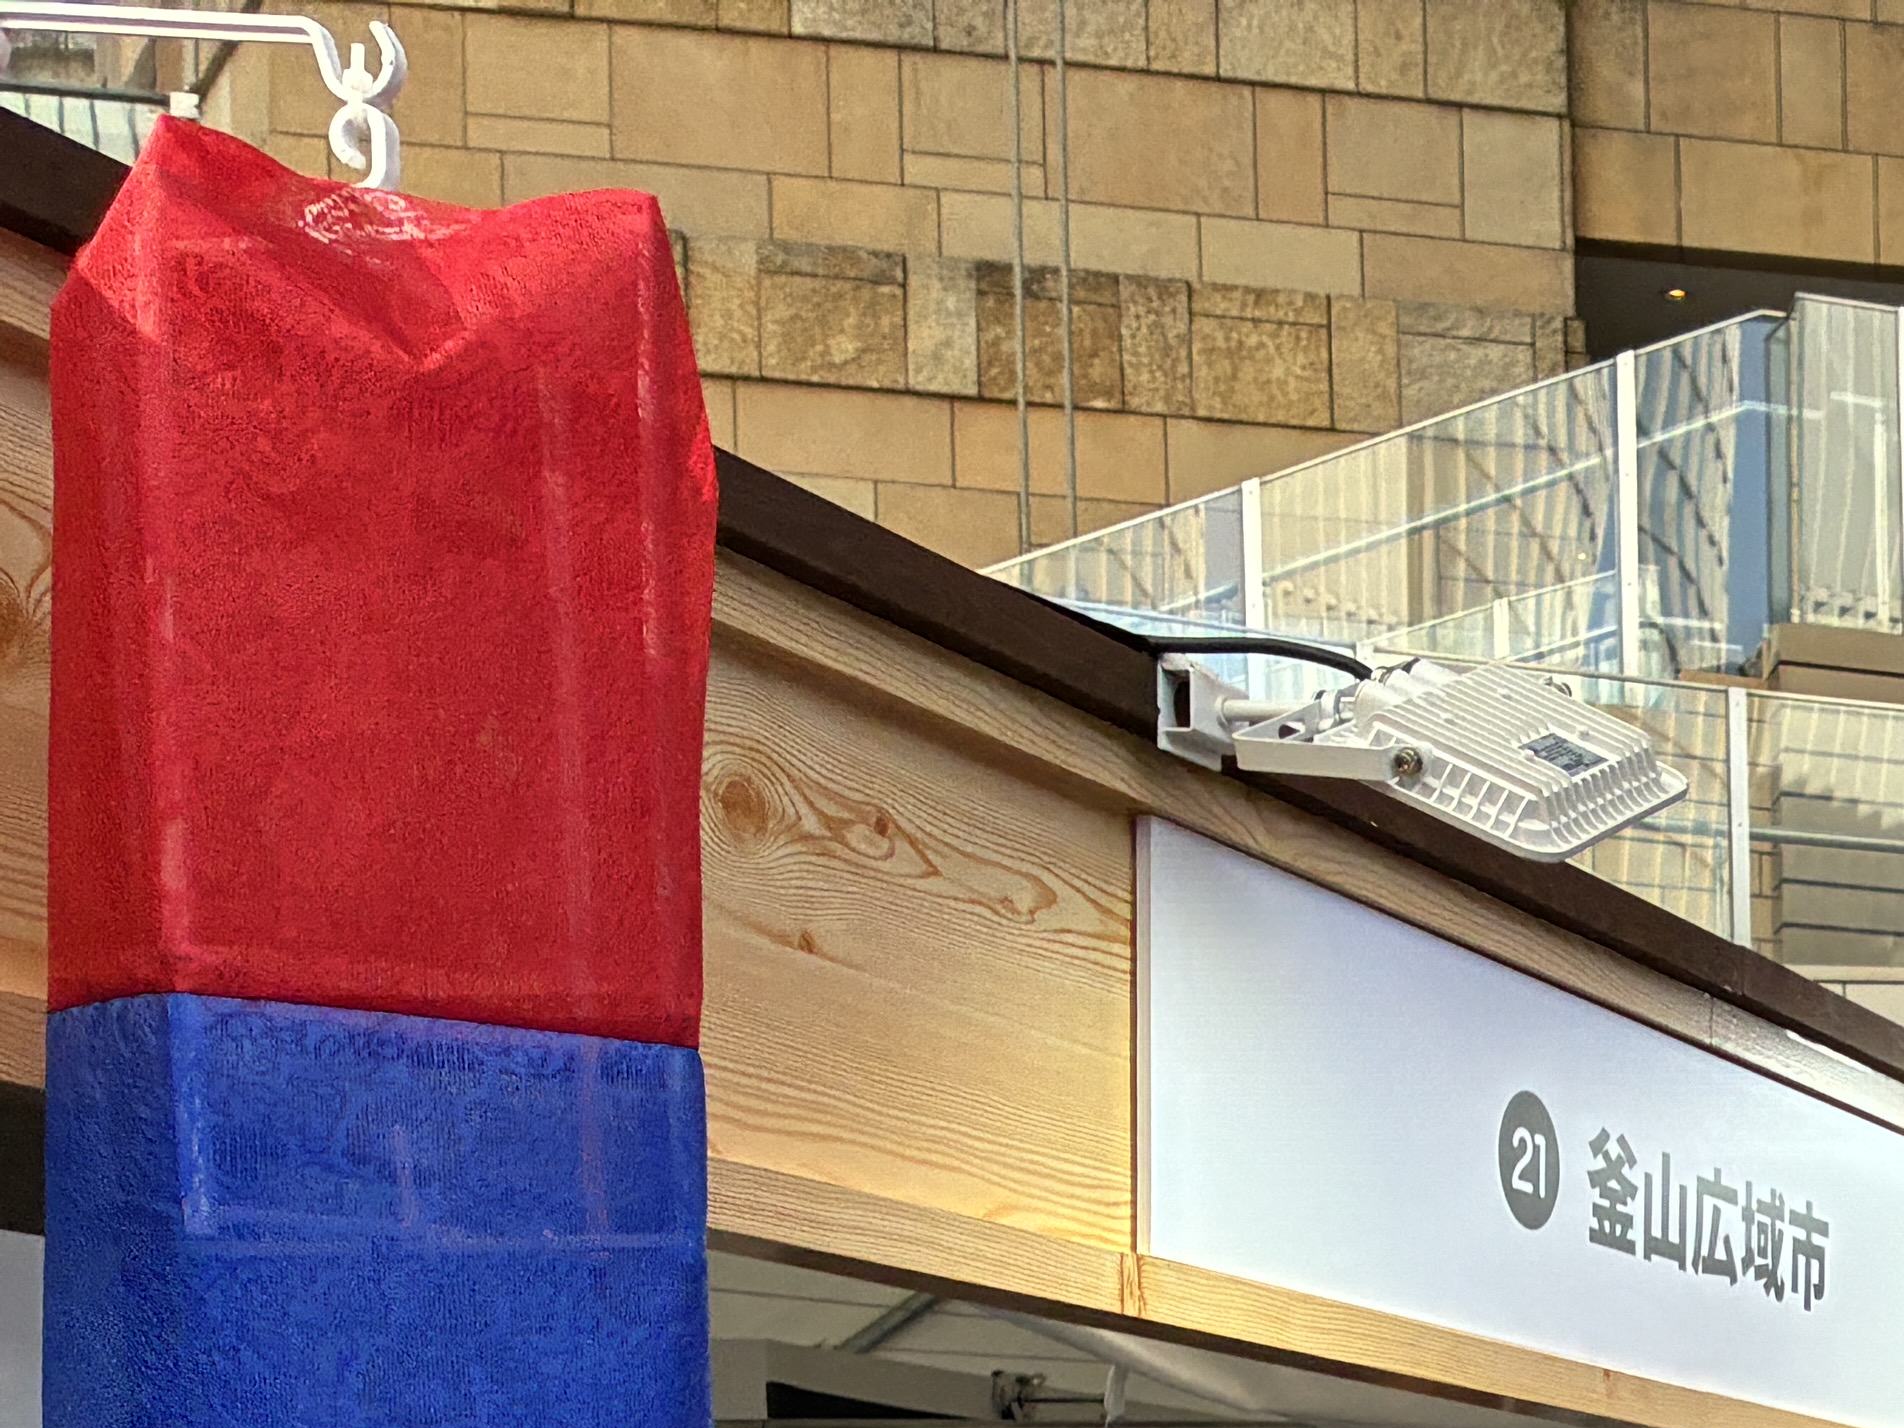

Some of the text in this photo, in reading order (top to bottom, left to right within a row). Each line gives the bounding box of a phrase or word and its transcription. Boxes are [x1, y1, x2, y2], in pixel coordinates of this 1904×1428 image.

[1511, 1126, 1830, 1312] 21 釜山広域市
